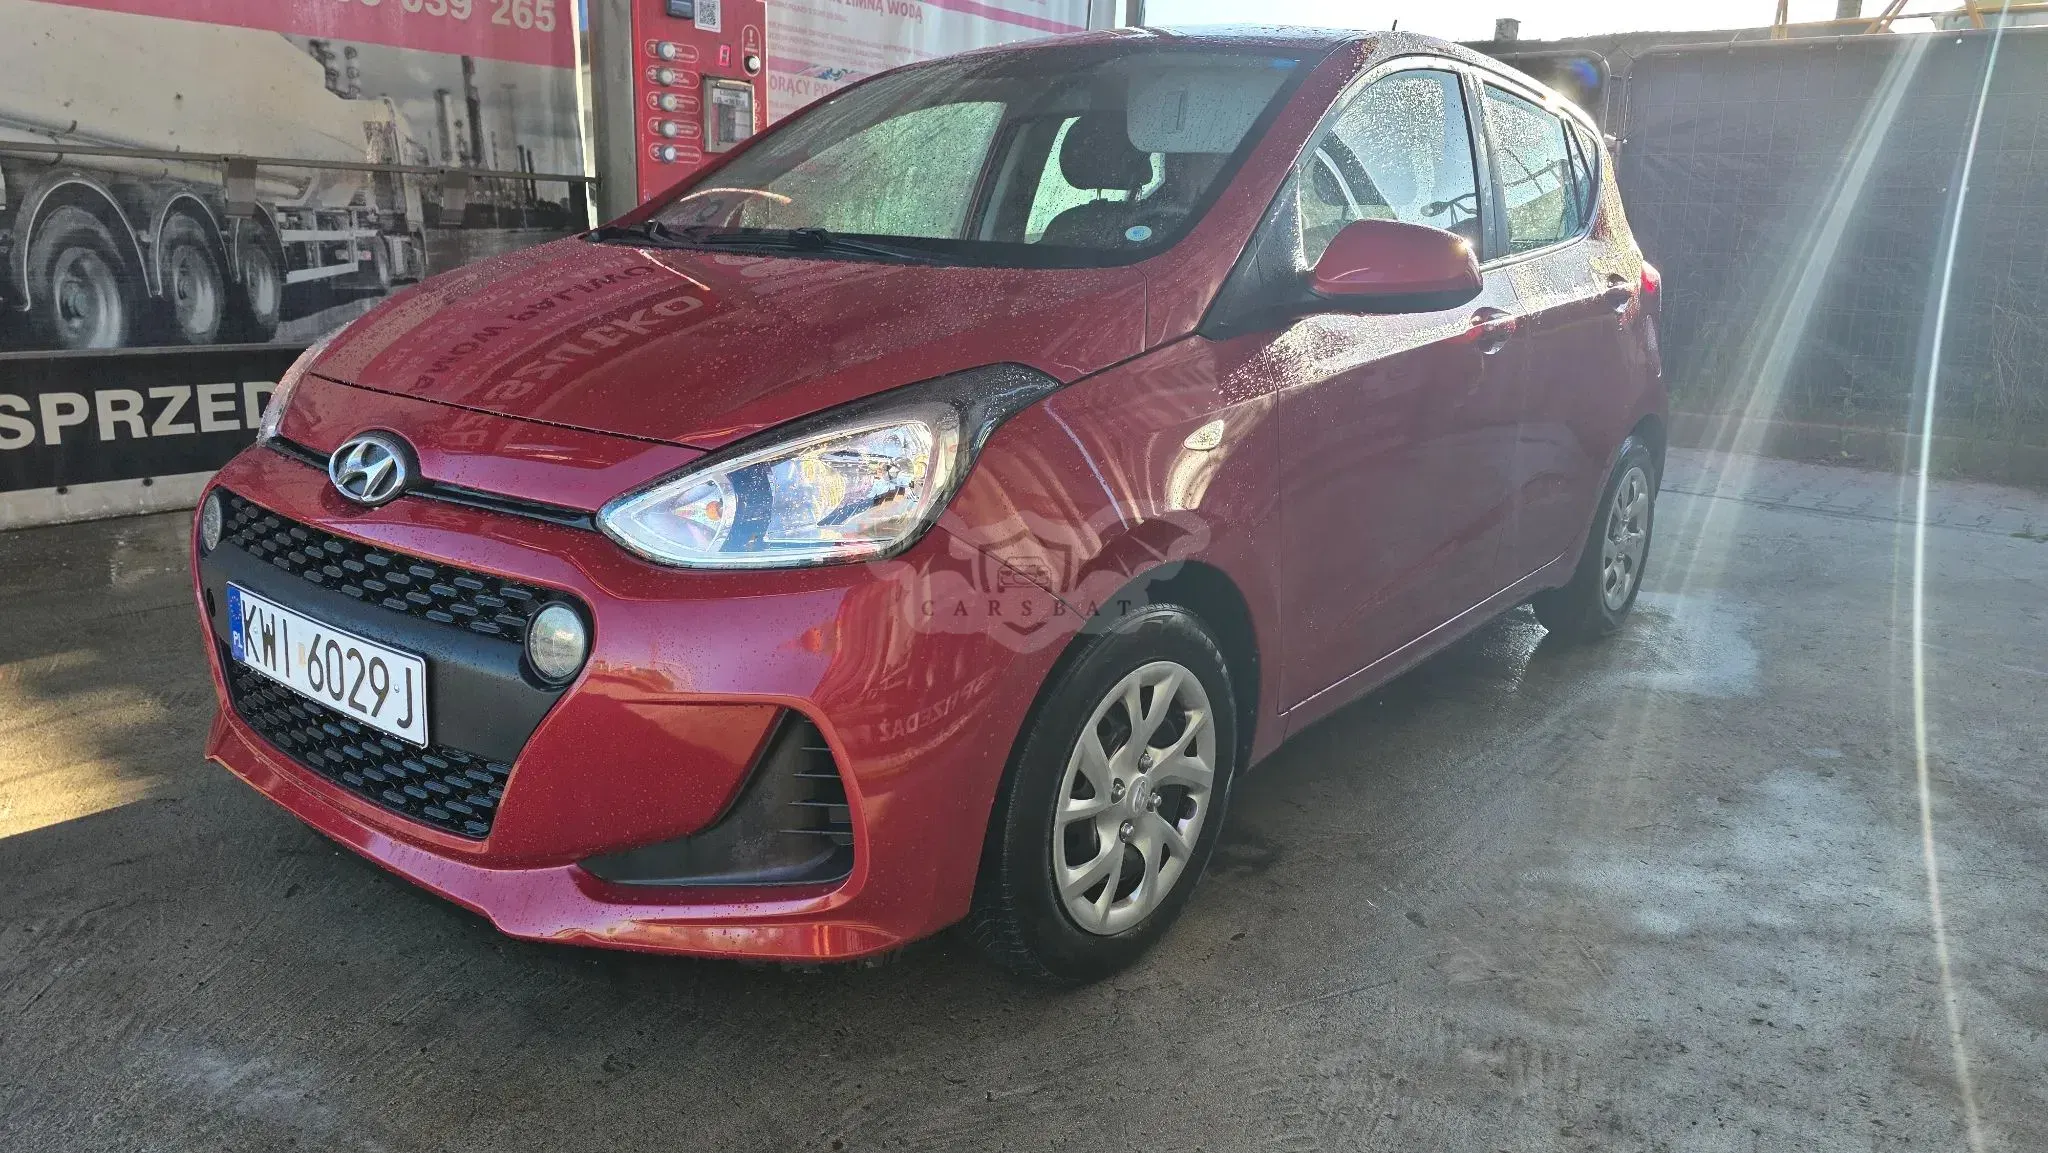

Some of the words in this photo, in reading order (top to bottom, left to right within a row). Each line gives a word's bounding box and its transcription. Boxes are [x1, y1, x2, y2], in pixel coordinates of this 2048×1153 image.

[491, 0, 556, 32] 265
[887, 0, 923, 24] WODĄ
[0, 381, 281, 450] SPRZED
[233, 631, 243, 649] PL
[242, 599, 290, 678] KWI
[307, 633, 413, 729] 6029J
